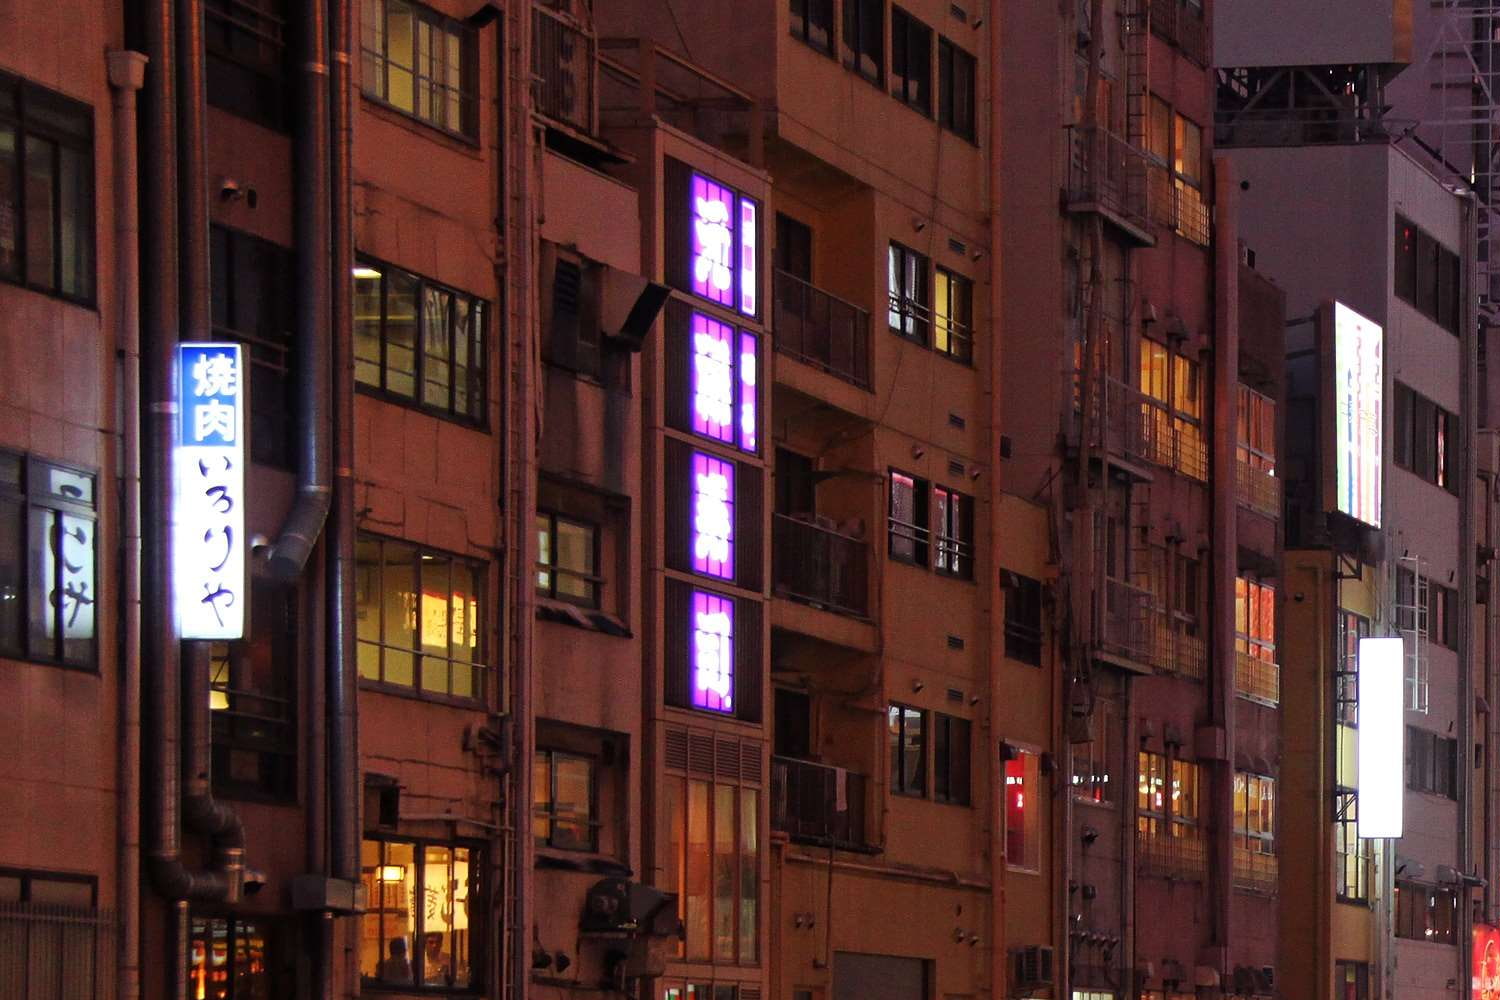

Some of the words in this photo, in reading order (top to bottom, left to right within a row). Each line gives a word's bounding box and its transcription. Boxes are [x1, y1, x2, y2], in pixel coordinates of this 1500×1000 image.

[193, 353, 237, 442] 焼肉
[198, 455, 235, 629] いろりや
